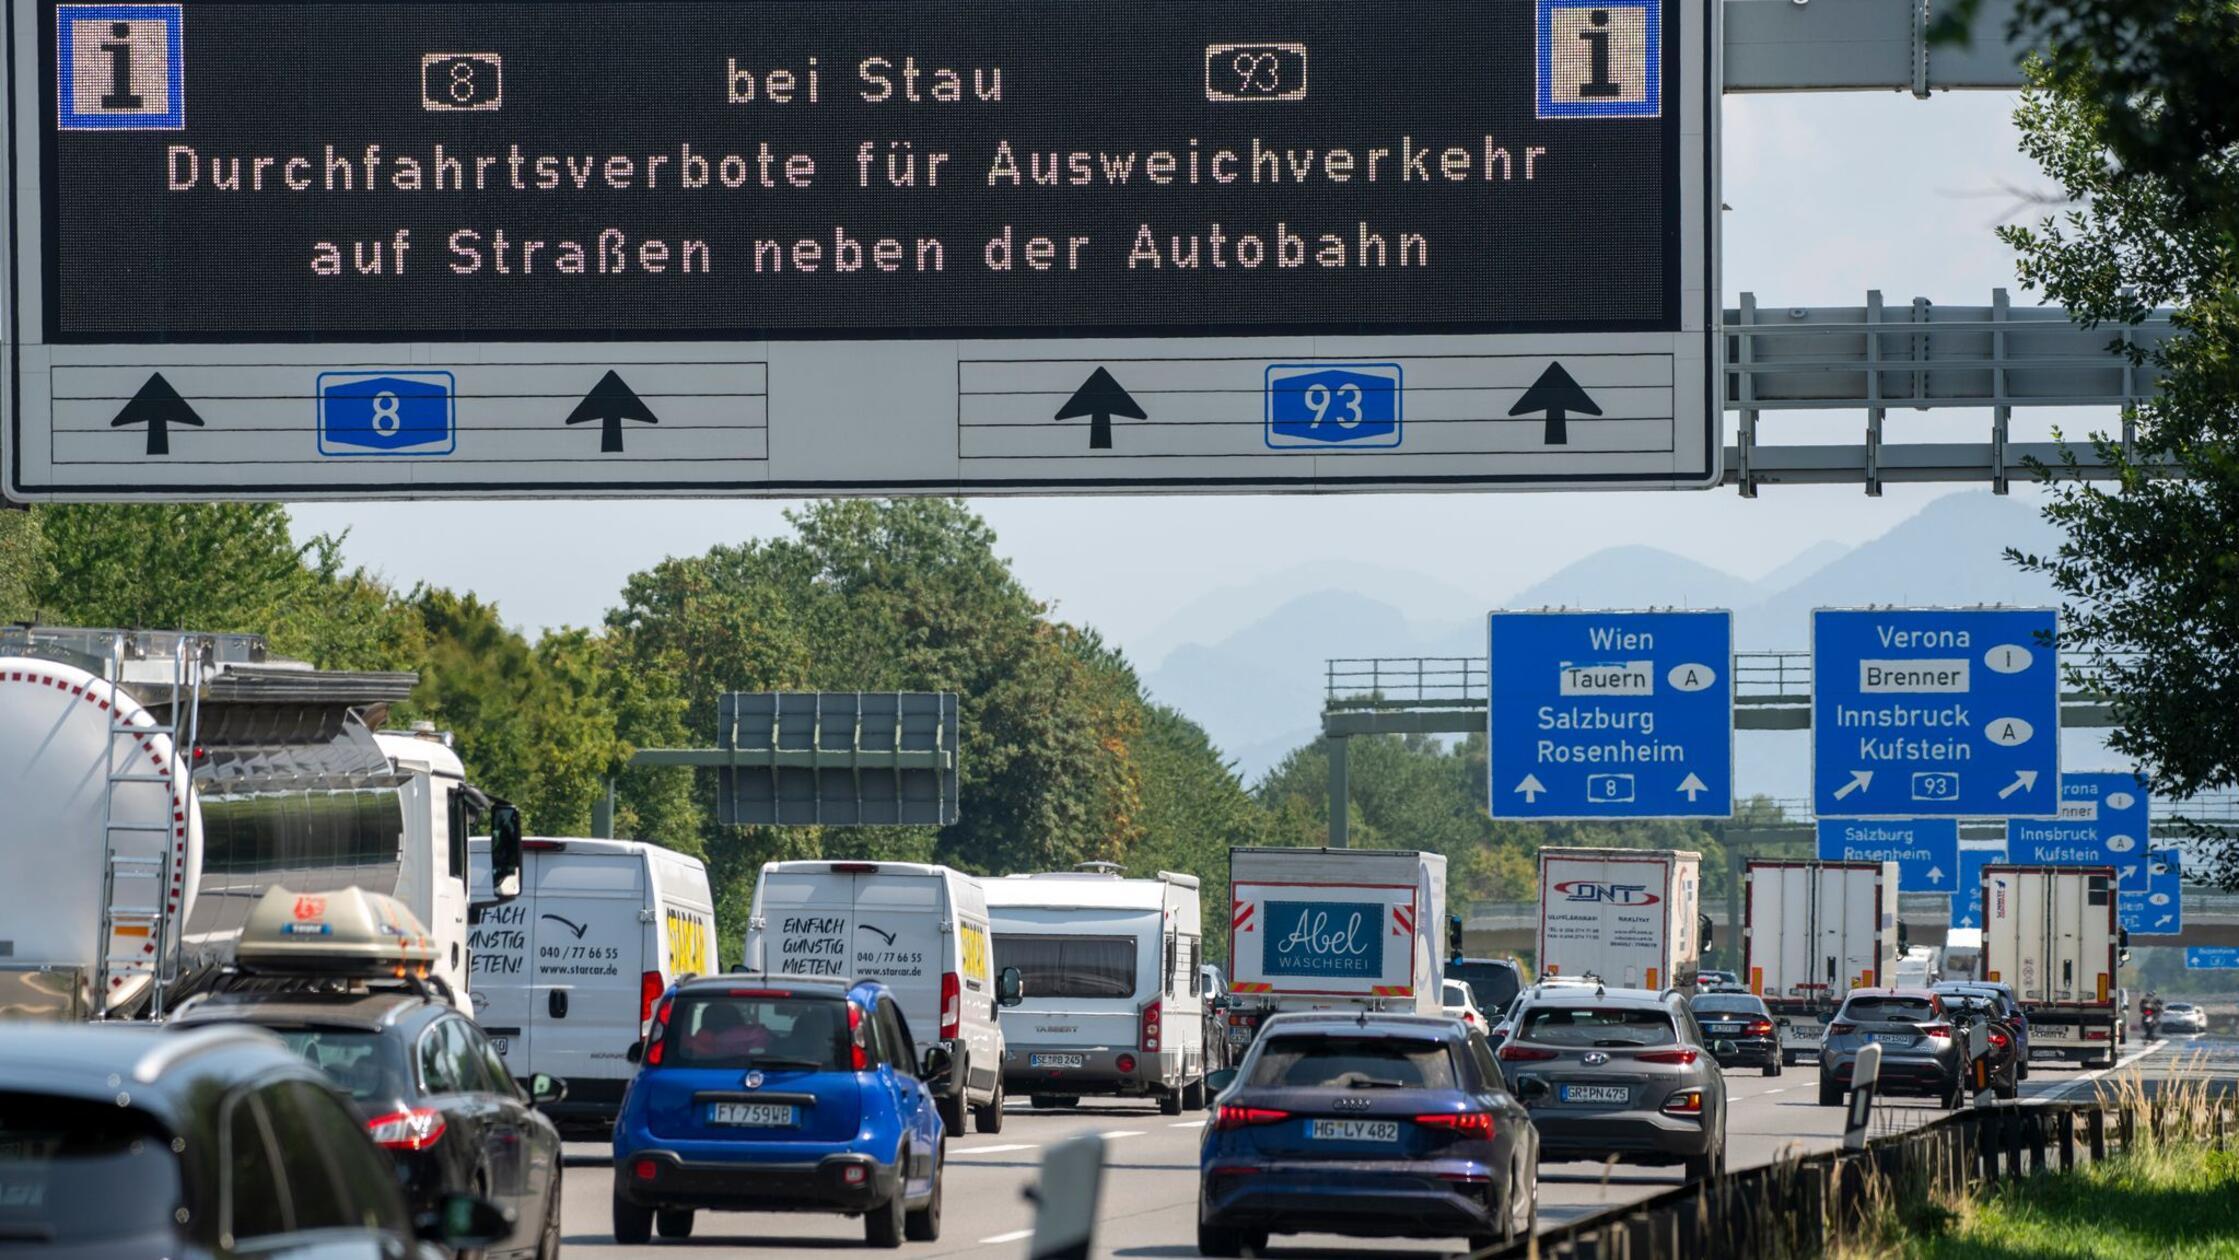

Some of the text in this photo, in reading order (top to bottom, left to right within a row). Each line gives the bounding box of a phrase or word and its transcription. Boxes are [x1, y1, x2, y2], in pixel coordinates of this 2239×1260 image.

[450, 62, 473, 101] 8
[728, 56, 1002, 104] bei Stau
[1233, 52, 1280, 92] 93
[166, 136, 1548, 192] Durchfahrtsverbote für Ausweichverkehr
[310, 222, 1428, 276] auf Straßen neben der Autobahn
[372, 390, 400, 437] 8
[1304, 382, 1365, 430] 93
[1589, 627, 1654, 651] Wien
[1877, 625, 1971, 649] Verona
[1569, 669, 1646, 689] Tauern
[1685, 669, 1699, 686] A
[1867, 667, 1961, 686] Brenner
[1537, 706, 1655, 735] Salzburg
[1837, 704, 1970, 728] Innsbruck
[2002, 723, 2016, 741] A
[1538, 739, 1684, 763] Rosenheim
[1860, 738, 1971, 761] Kufstein
[1605, 780, 1617, 797] 8
[1924, 778, 1947, 796] 93
[2062, 783, 2099, 795] rona
[2062, 806, 2092, 817] nner
[1844, 827, 1914, 844] Salzburg
[2020, 827, 2099, 842] Innsbruck
[2034, 847, 2099, 862] Kufstein
[481, 906, 526, 925] FACH
[1278, 908, 1368, 955] Abel
[539, 946, 560, 958] 040
[572, 946, 586, 959] 77
[589, 947, 602, 959] 66
[605, 947, 618, 960] 55
[857, 951, 874, 962] 040
[884, 952, 895, 962] 77
[897, 952, 908, 963] 66
[911, 953, 922, 963] 55
[471, 954, 523, 974] ETEN!
[539, 963, 618, 976] www.starcar.de
[1279, 956, 1369, 970] WÄSCHEREI
[1567, 1086, 1626, 1099] GR PN 475
[718, 1103, 736, 1122] FY
[1314, 1122, 1396, 1139] HG LY 482
